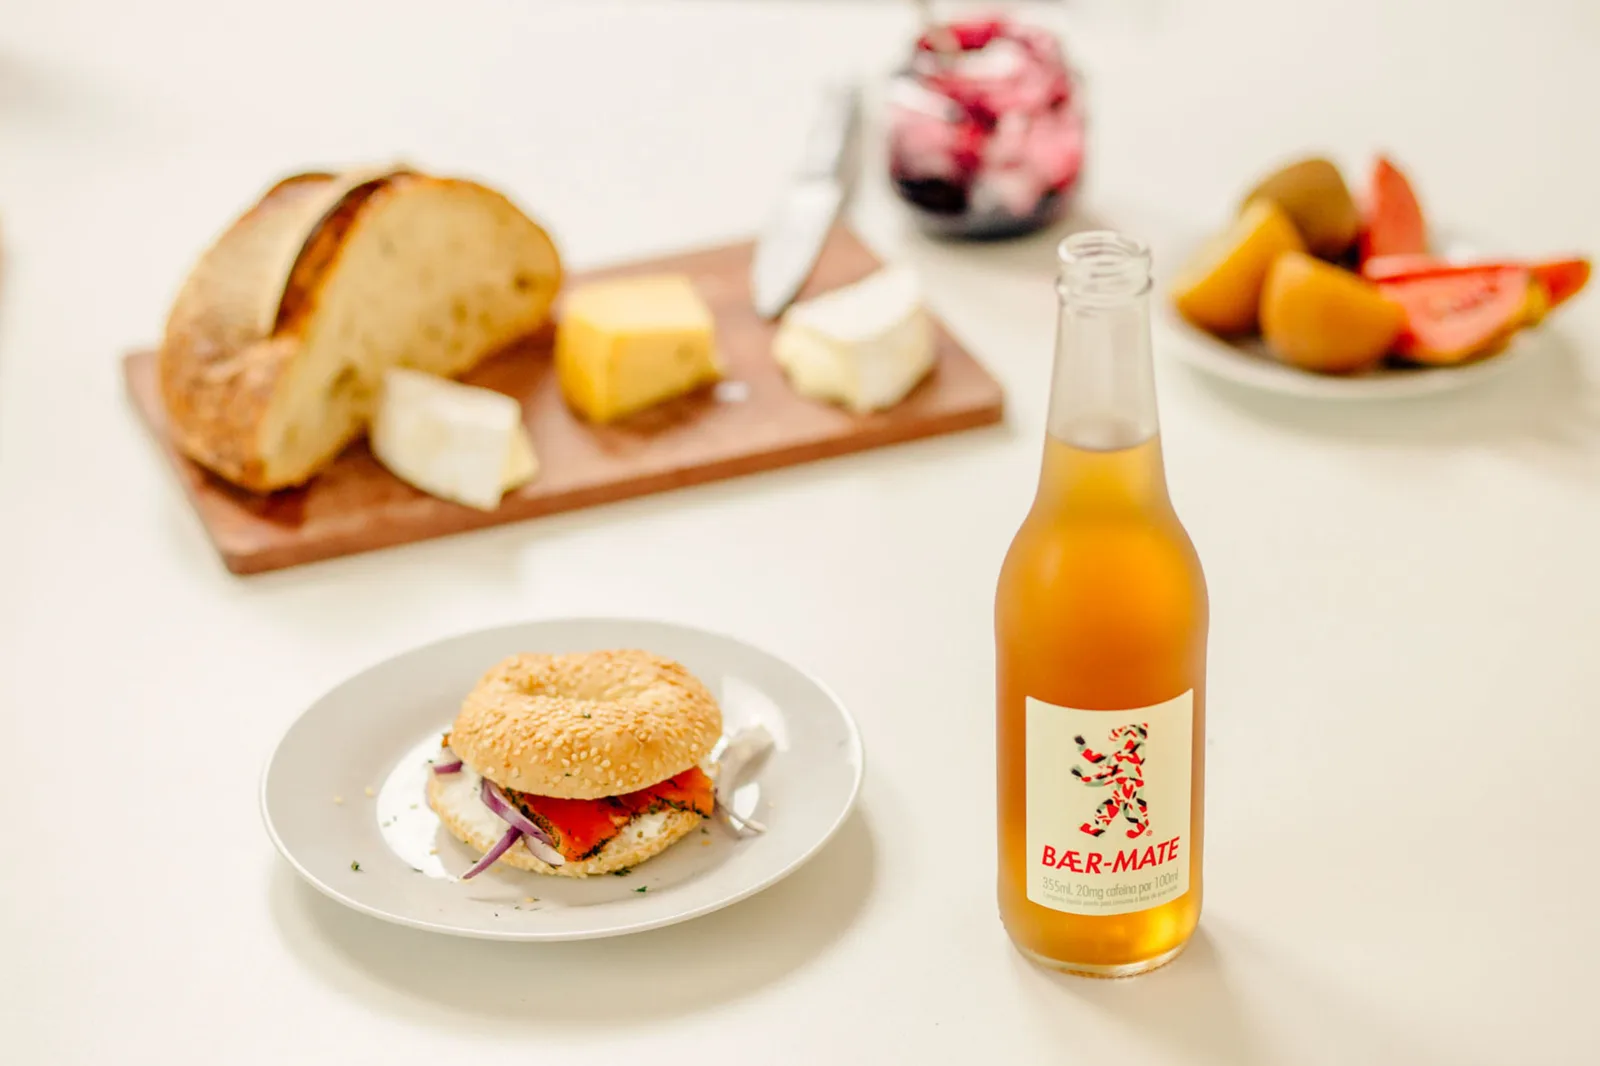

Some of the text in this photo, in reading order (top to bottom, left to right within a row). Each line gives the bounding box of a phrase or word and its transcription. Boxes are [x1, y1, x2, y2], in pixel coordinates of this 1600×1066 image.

[1042, 836, 1180, 874] BÆR-MATE
[1076, 884, 1103, 900] 20mg
[1139, 882, 1154, 899] por
[1155, 867, 1179, 889] 100ml
